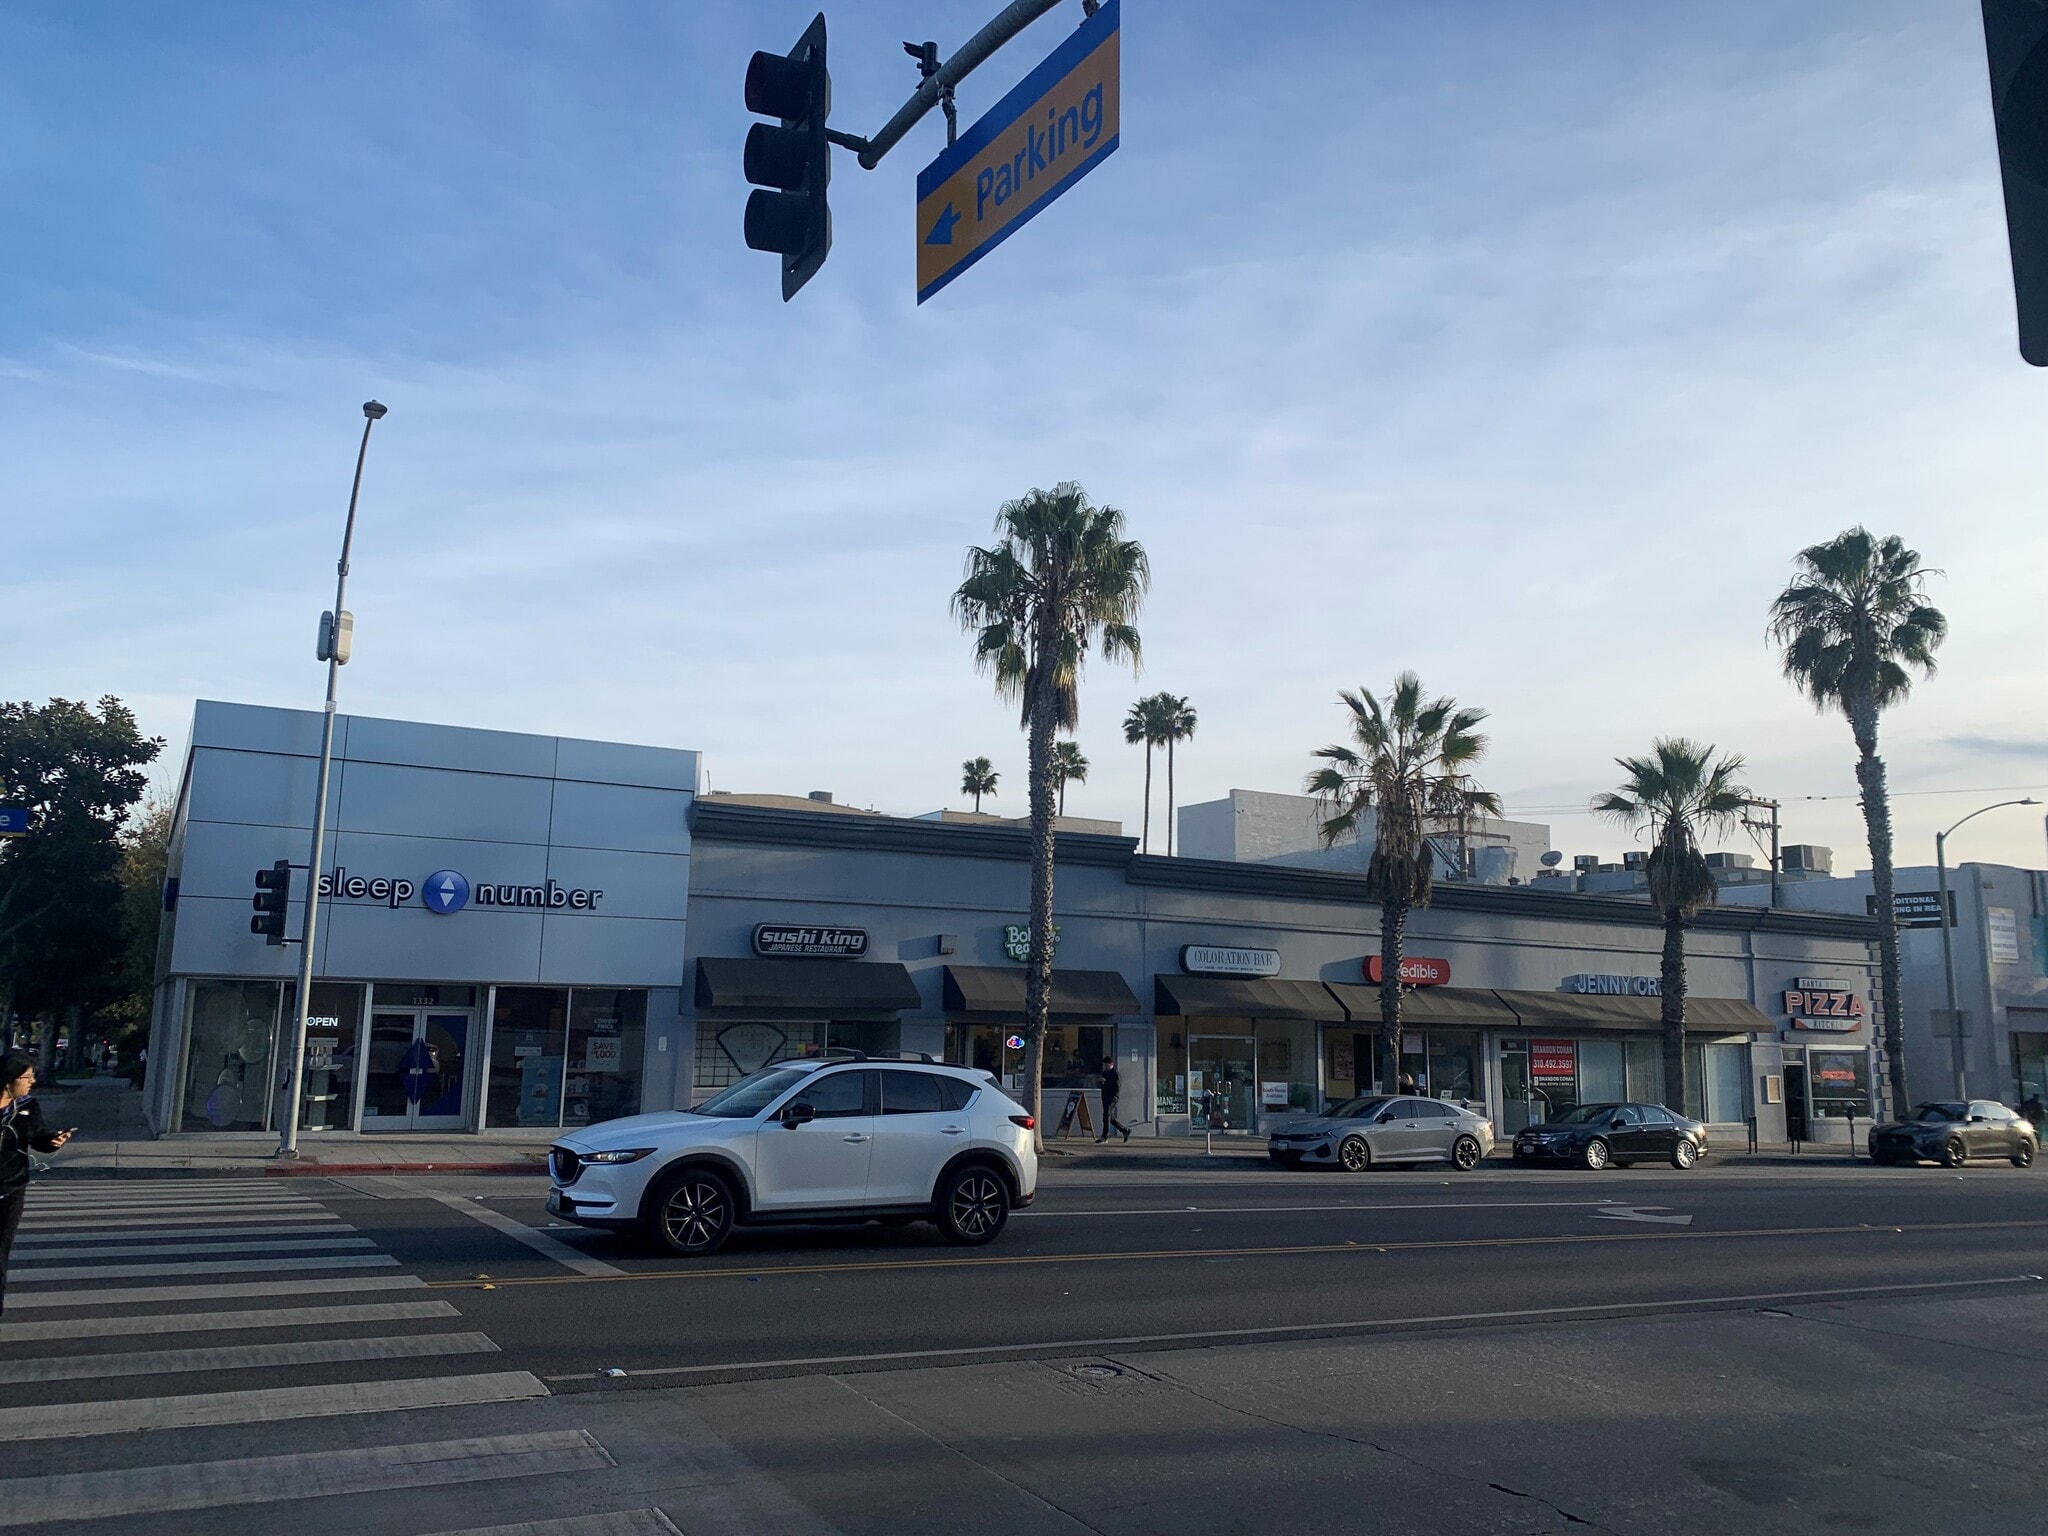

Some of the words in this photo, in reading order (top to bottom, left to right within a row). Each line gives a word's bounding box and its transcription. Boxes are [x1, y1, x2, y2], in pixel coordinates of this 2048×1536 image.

[977, 81, 1102, 222] Parking
[318, 867, 414, 909] sleep
[475, 879, 603, 910] number
[1895, 896, 1936, 904] DITIONAL
[761, 930, 817, 944] sushi
[820, 930, 864, 949] king
[769, 944, 802, 952] JAPANESE
[1194, 950, 1251, 964] COLORATION
[1253, 953, 1272, 966] BAR
[1401, 964, 1438, 978] edible
[1577, 973, 1630, 994] JENNY
[1635, 976, 1662, 996] CR
[412, 997, 434, 1005] 1332
[1784, 991, 1866, 1016] PIZZA
[306, 1016, 339, 1027] OPEN
[593, 1042, 615, 1050] SAVE
